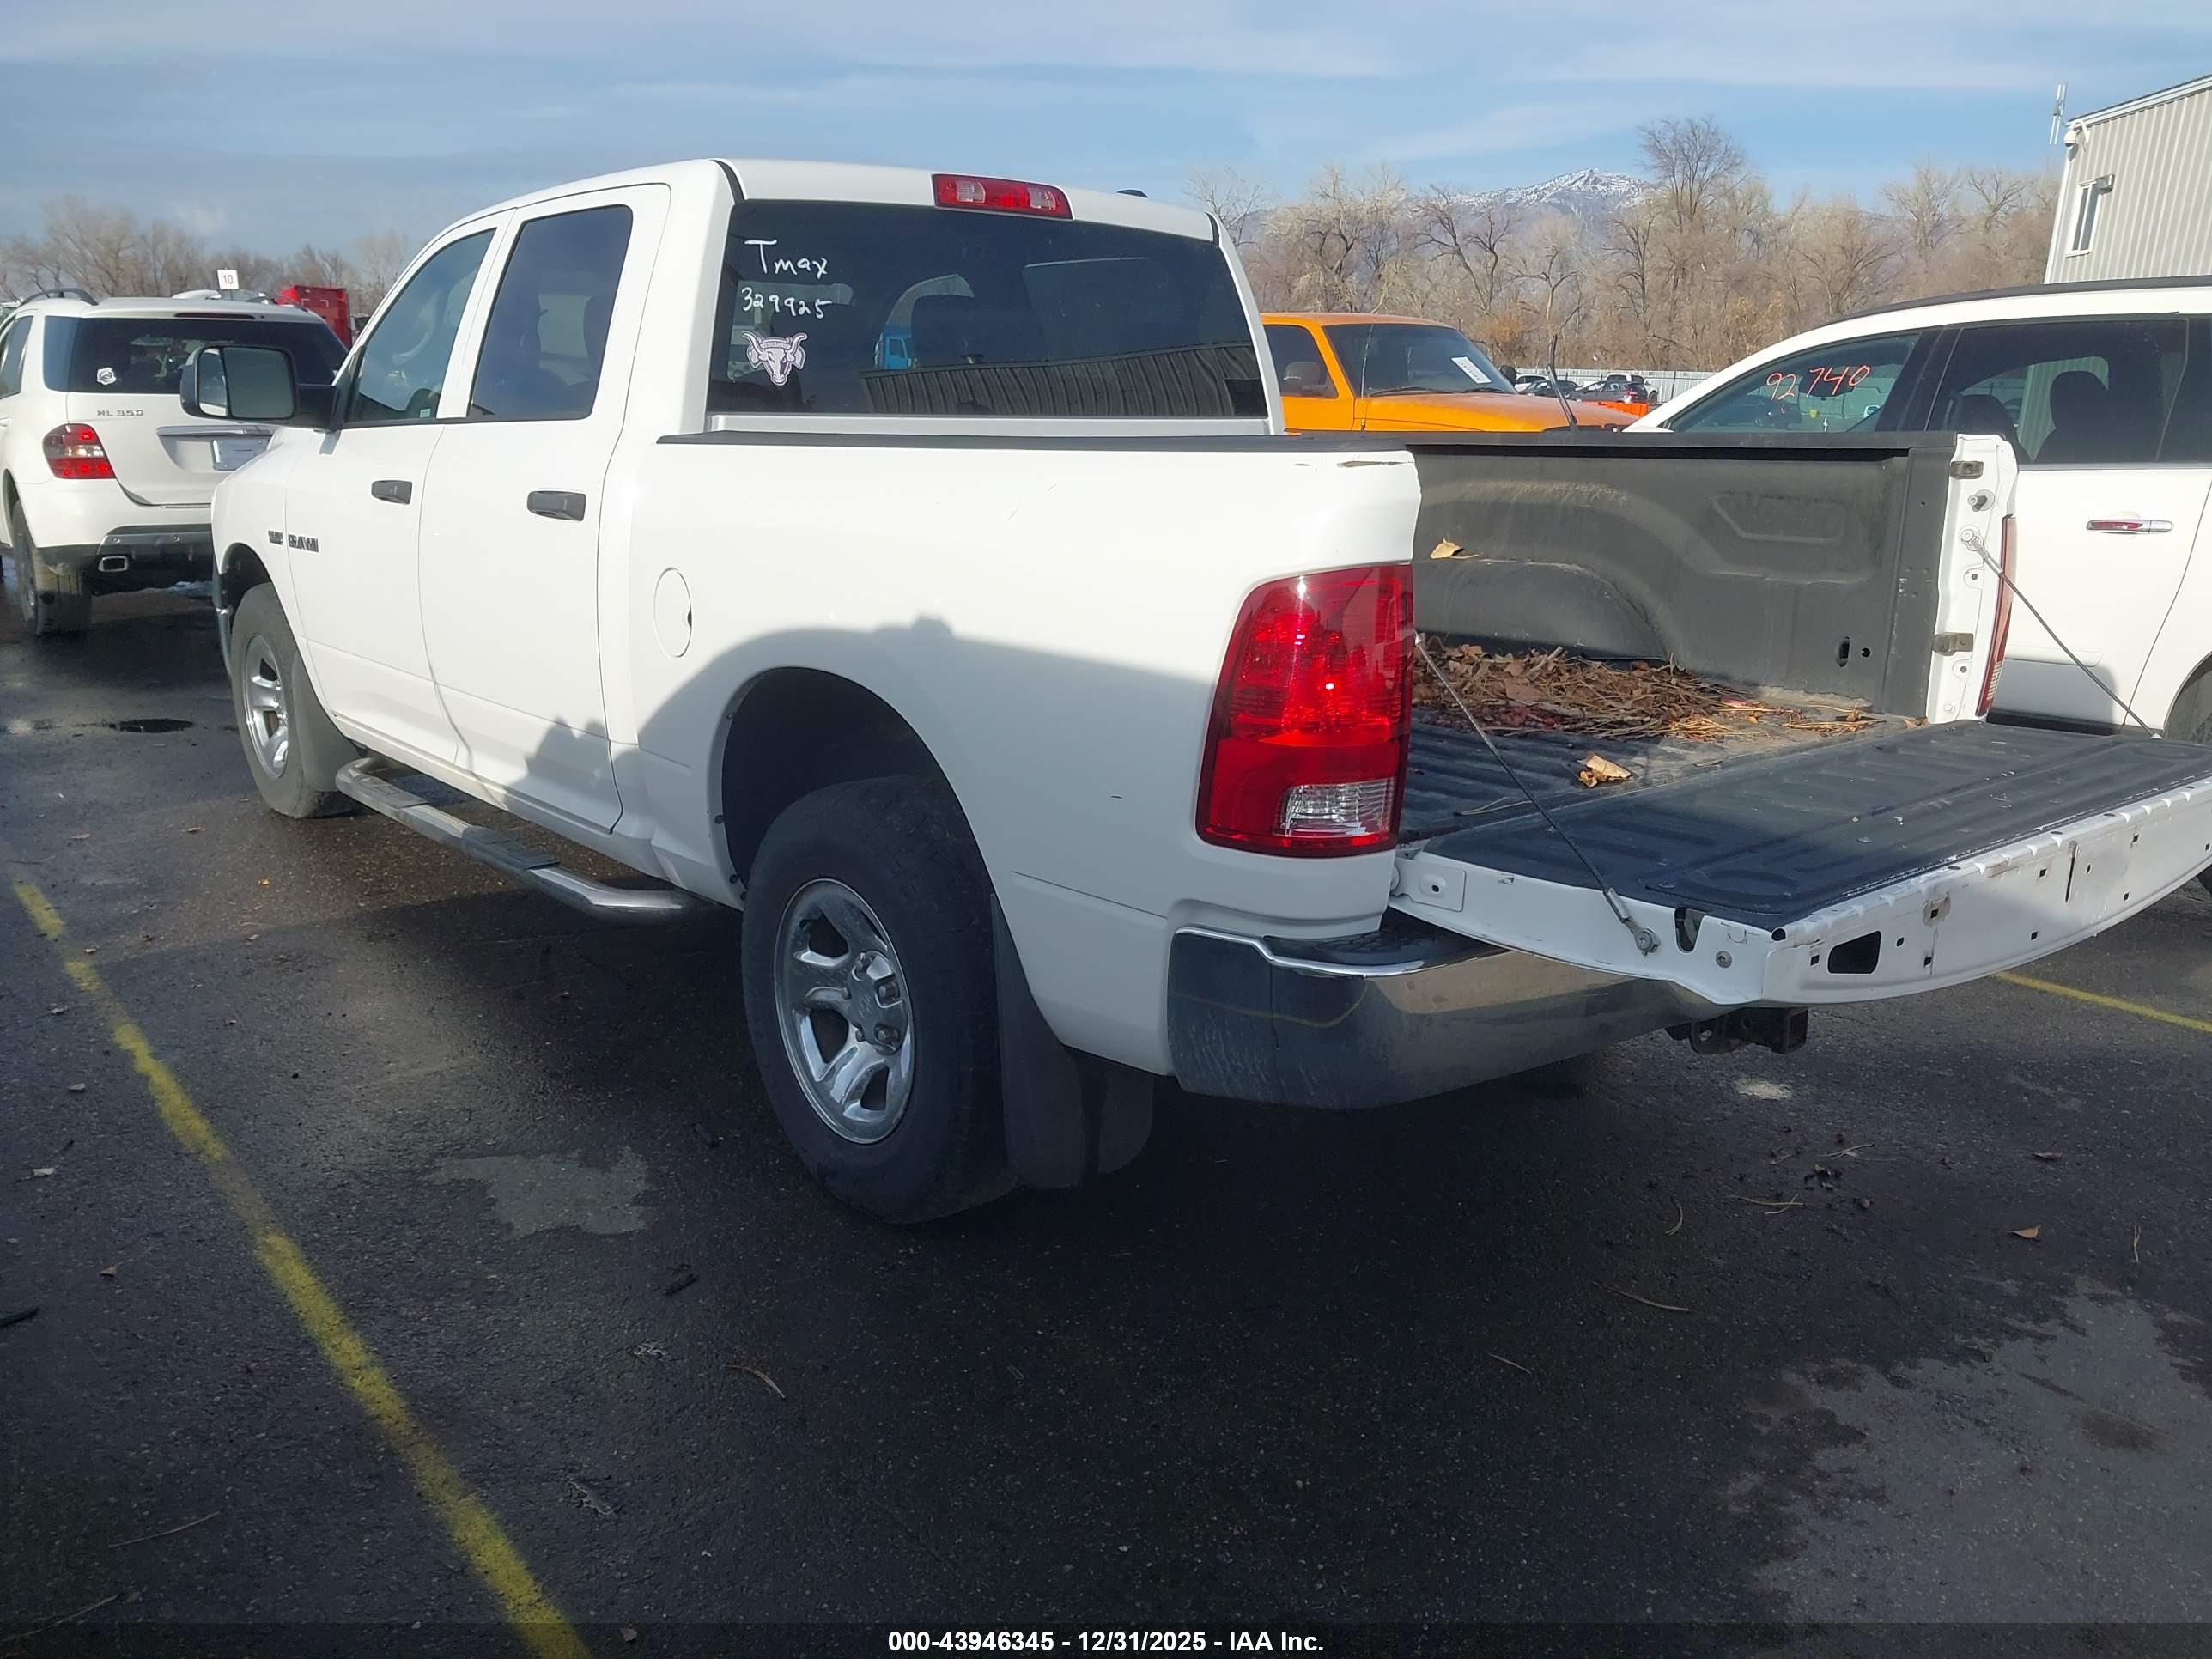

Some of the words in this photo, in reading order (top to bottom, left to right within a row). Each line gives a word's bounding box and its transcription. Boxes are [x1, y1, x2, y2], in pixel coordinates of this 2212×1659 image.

[744, 239, 829, 279] Tmax
[222, 274, 234, 284] 10
[741, 286, 833, 319] 329925
